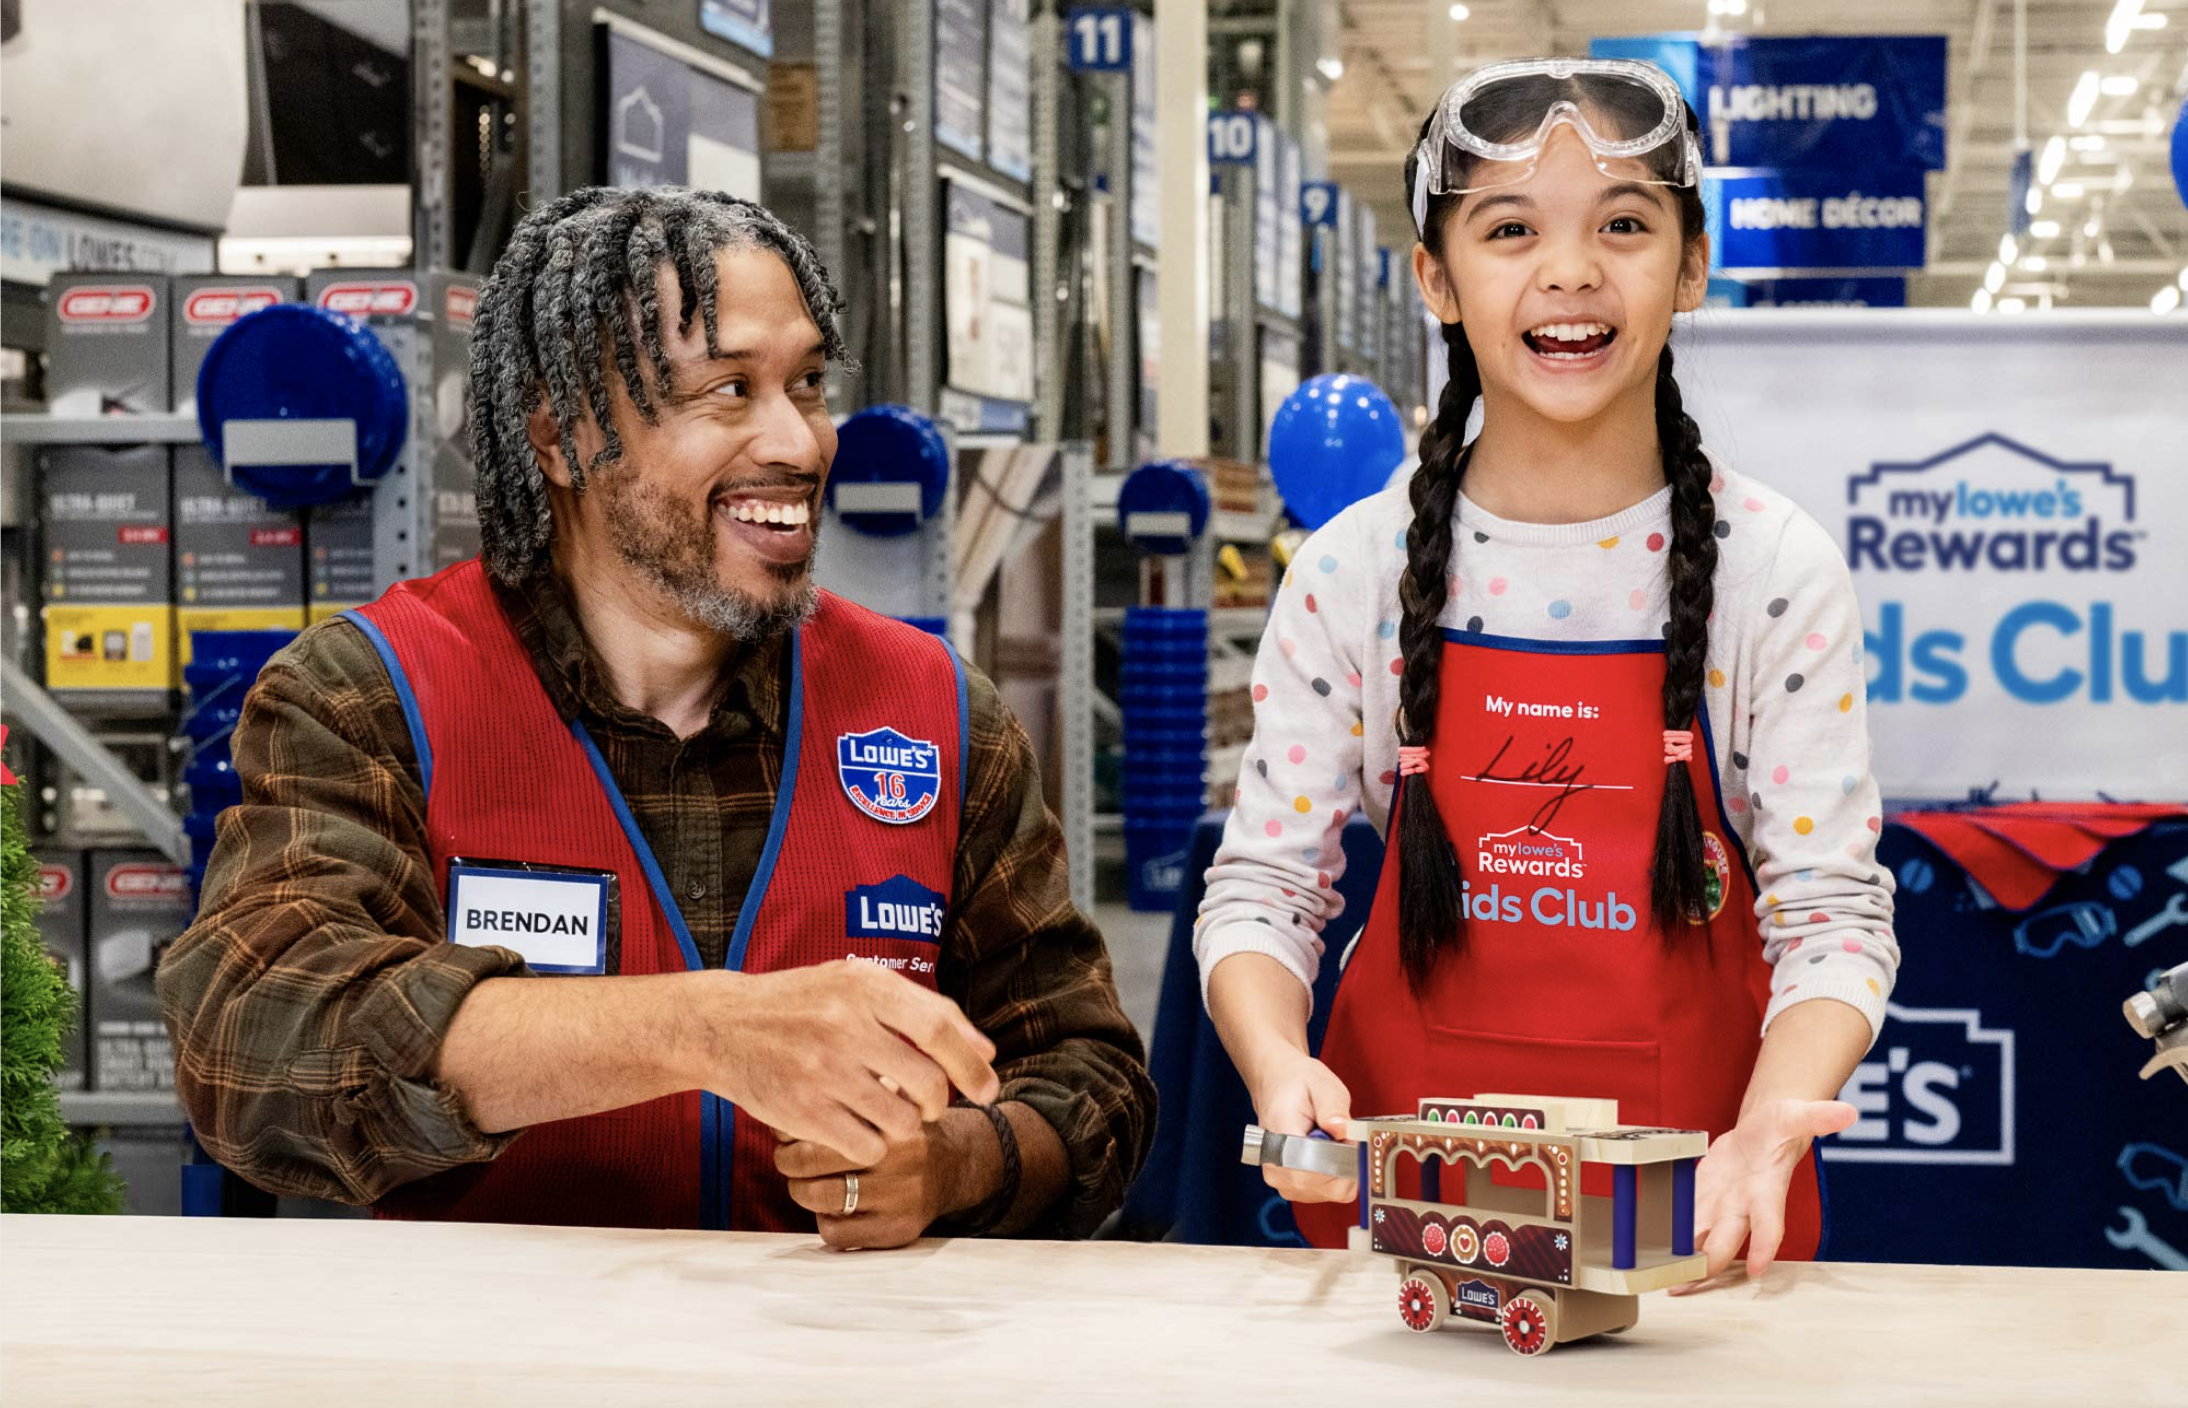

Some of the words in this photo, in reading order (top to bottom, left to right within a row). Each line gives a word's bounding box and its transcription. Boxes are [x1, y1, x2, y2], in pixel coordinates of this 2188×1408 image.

[1074, 15, 1121, 64] 11
[1708, 84, 1877, 121] LIGHTING
[1208, 117, 1252, 158] 10
[1303, 187, 1329, 220] 9
[1730, 197, 1818, 229] HOME
[1821, 190, 1922, 229] DÉCOR
[1864, 600, 1969, 703] ds
[1991, 600, 2188, 704] Clu
[1486, 695, 1513, 717] My
[1517, 702, 1573, 717] name
[1577, 701, 1599, 719] is:
[850, 739, 928, 768] LOWE'S
[849, 785, 897, 819] EXCELLENCE
[898, 809, 906, 819] IN
[906, 792, 933, 817] SERVICE
[874, 772, 906, 799] 16
[875, 794, 911, 808] Years
[1476, 735, 1594, 836] Lily
[466, 909, 588, 936] BRENDAN
[860, 896, 943, 937] LOWE'S
[1462, 880, 1523, 923] ids
[1530, 887, 1637, 931] Club
[846, 953, 908, 969] Ctomer
[1838, 1047, 1961, 1145] E'S
[1461, 1286, 1495, 1305] LOWE'S
